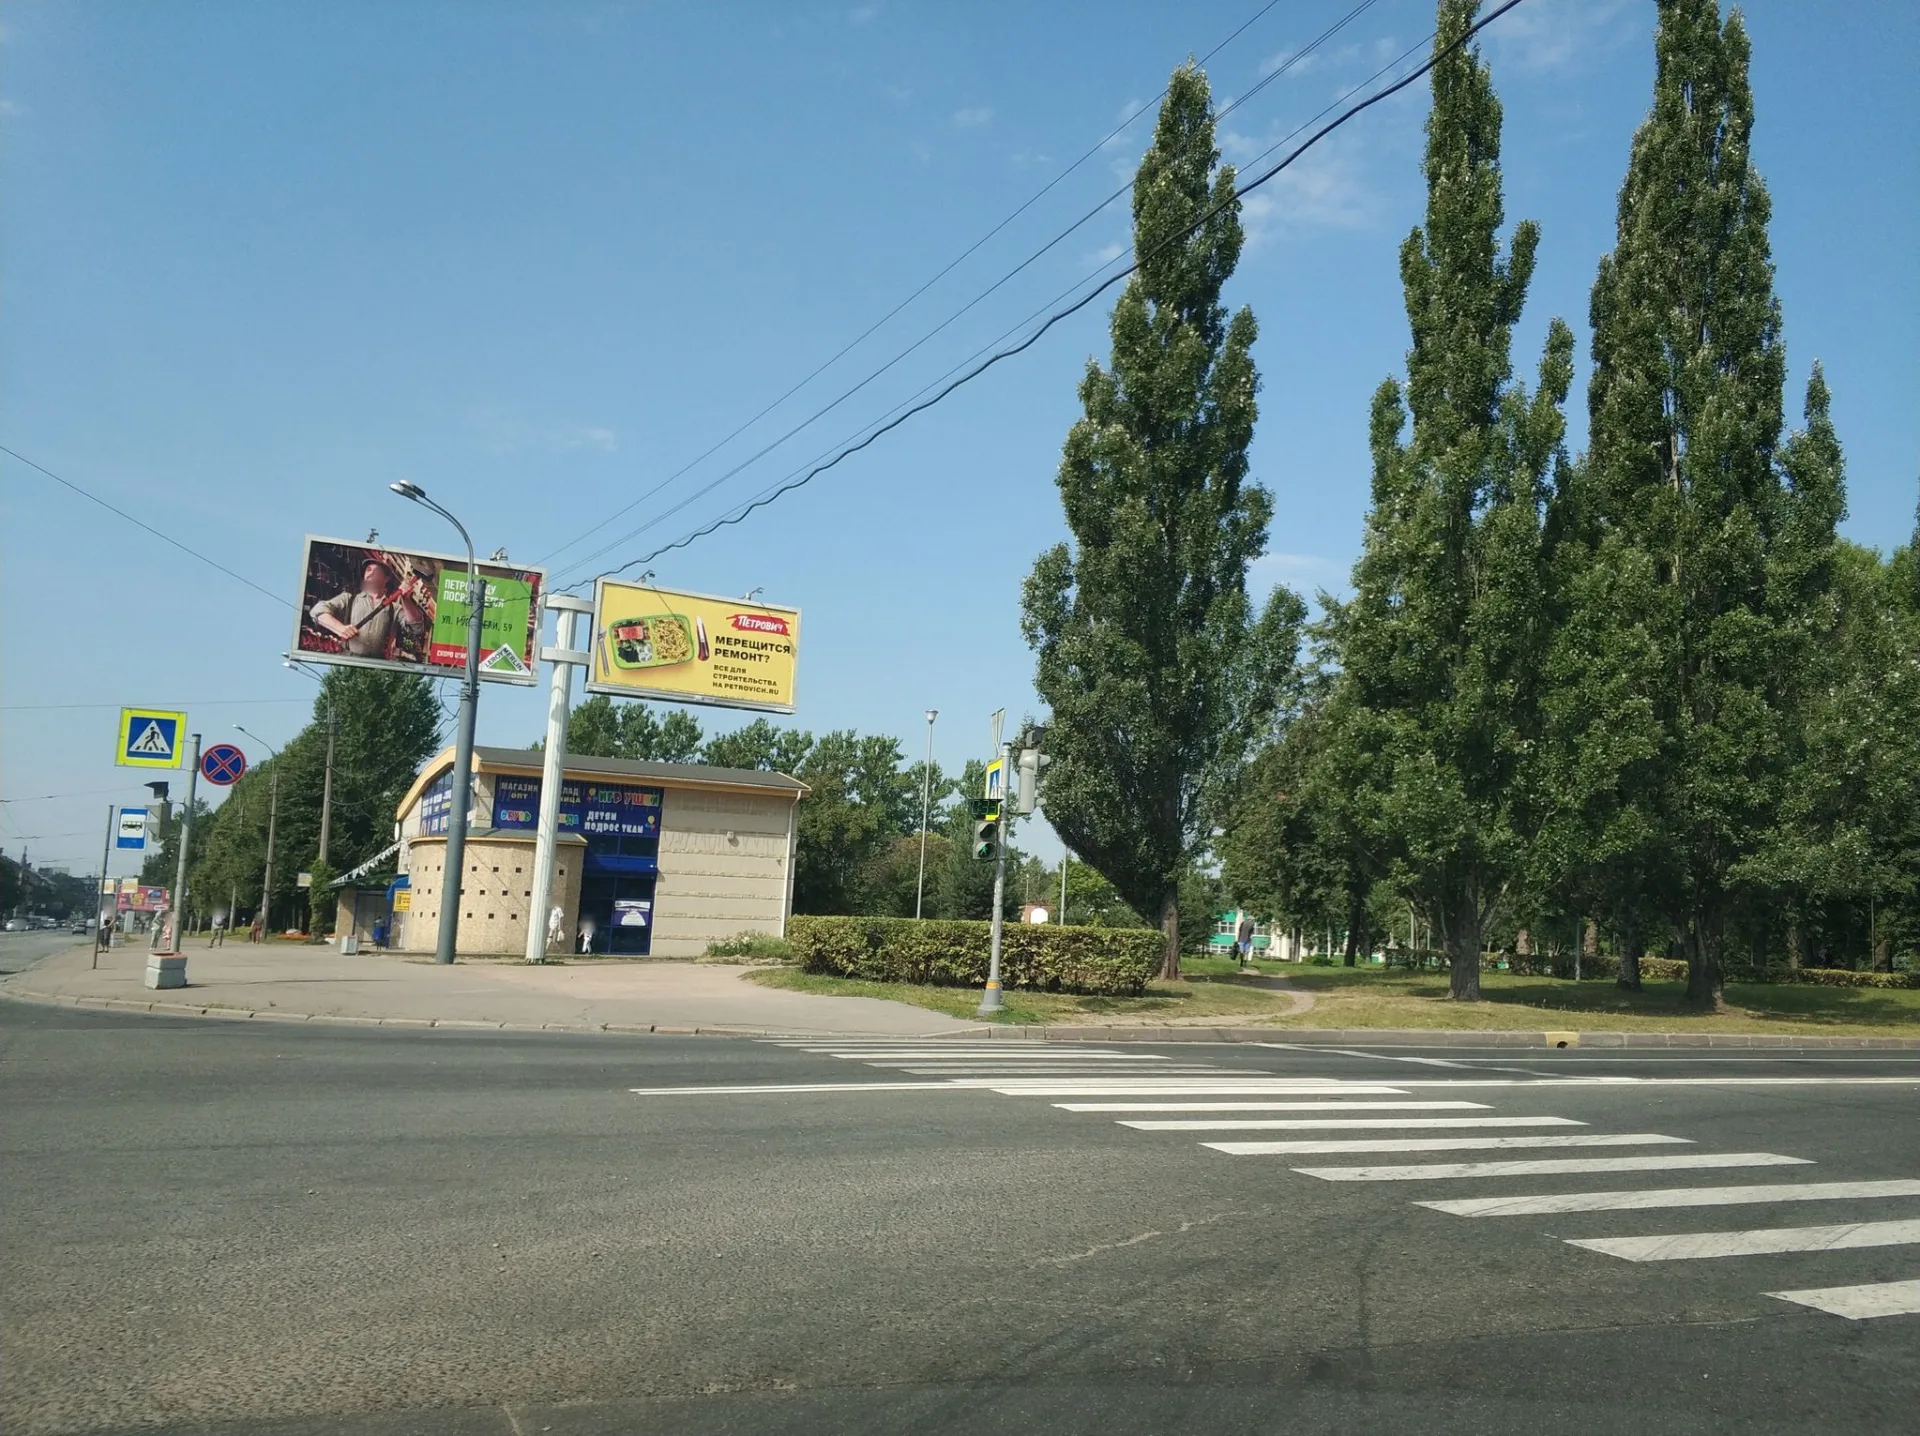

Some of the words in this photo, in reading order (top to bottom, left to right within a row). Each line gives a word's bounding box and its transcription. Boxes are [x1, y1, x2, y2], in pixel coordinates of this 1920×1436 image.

[441, 615, 453, 626] УЛ.
[503, 623, 513, 632] 59
[715, 635, 791, 654] МЕРЕЩИТСЯ
[484, 650, 504, 668] LEROY
[502, 647, 524, 671] MERLIN
[714, 648, 770, 663] РЕМОНТ?
[713, 664, 729, 672] ВСЕ
[729, 666, 747, 674] ДЛЯ
[712, 673, 778, 687] СТРОИТЕЛЬСТВА
[724, 683, 780, 695] PETROVICH.RU
[501, 782, 539, 792] МАГАЗИН
[586, 810, 617, 821] ДЕТЯМ
